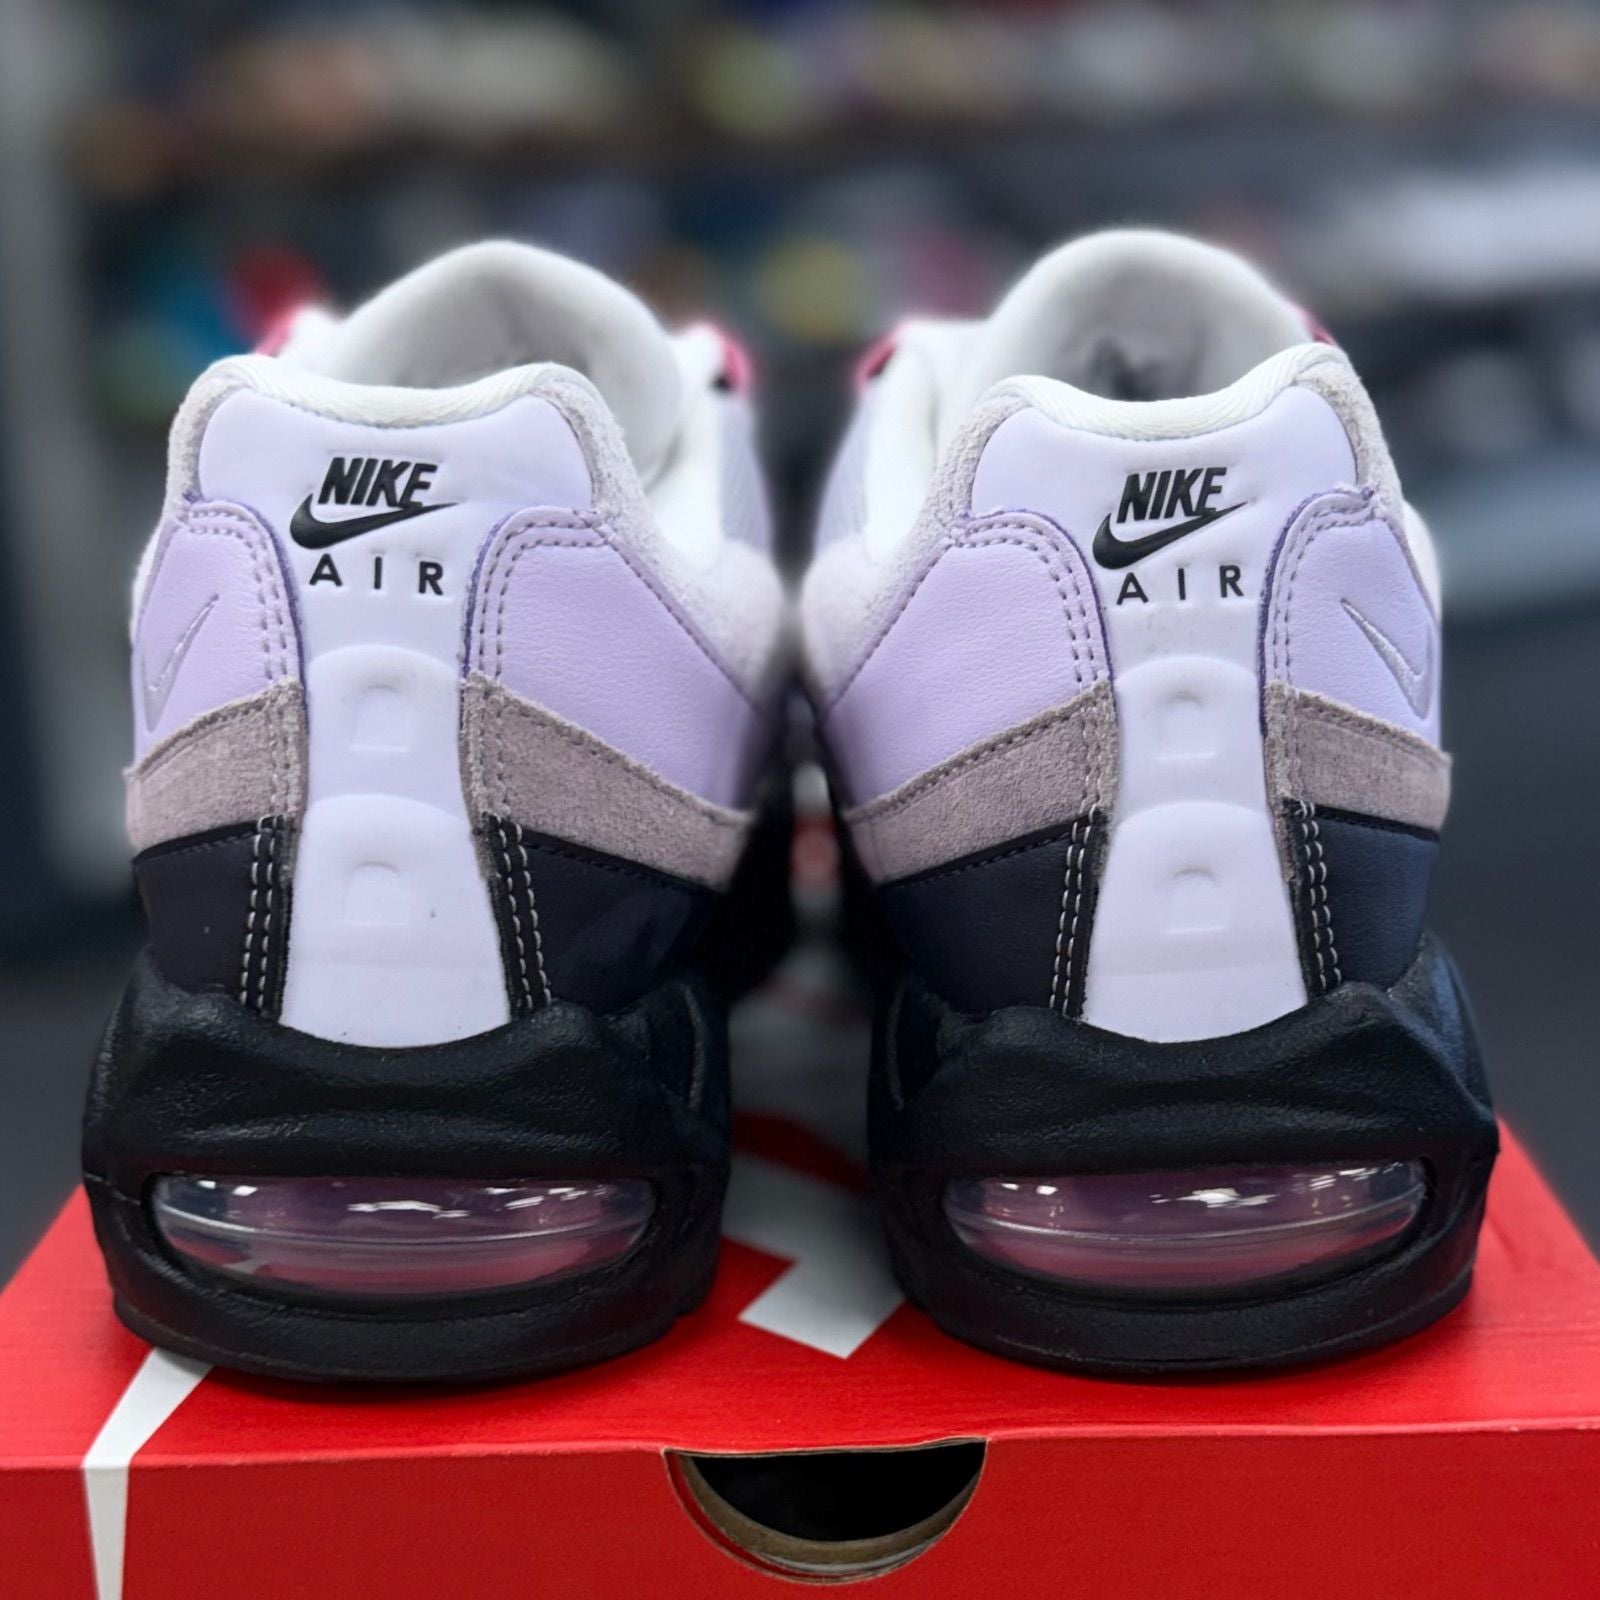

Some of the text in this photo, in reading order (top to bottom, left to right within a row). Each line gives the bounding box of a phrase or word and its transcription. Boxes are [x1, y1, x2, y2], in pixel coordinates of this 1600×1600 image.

[317, 457, 438, 508] NIKE
[1116, 467, 1227, 524] NIKE
[309, 553, 443, 596] AIR
[1116, 565, 1244, 606] AIR
